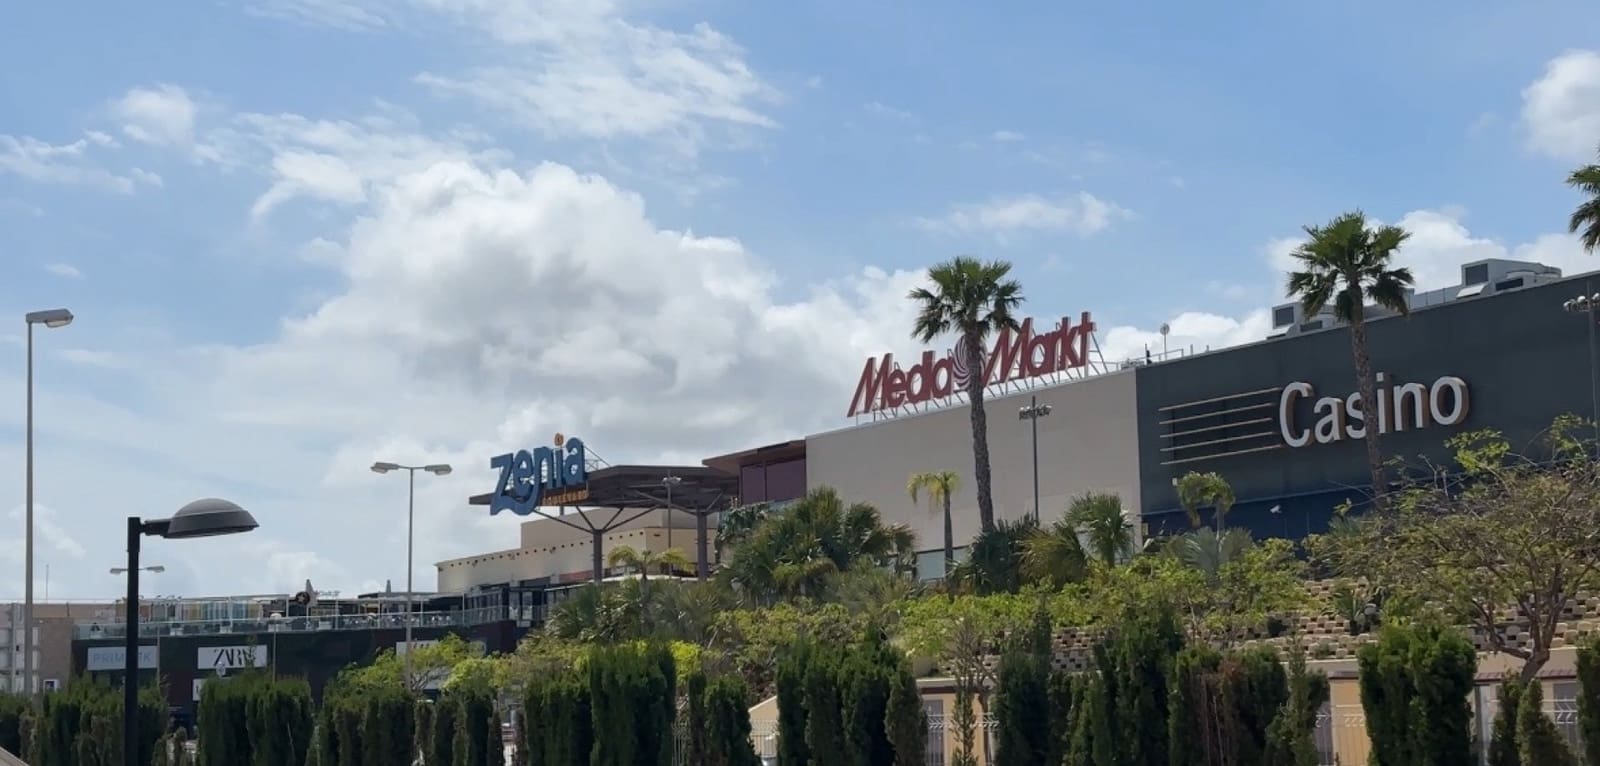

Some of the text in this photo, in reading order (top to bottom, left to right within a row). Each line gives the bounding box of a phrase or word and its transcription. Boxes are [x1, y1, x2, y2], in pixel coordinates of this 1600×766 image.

[981, 311, 1097, 388] Markt
[1279, 371, 1468, 449] Casino
[93, 652, 152, 665] PRIMK
